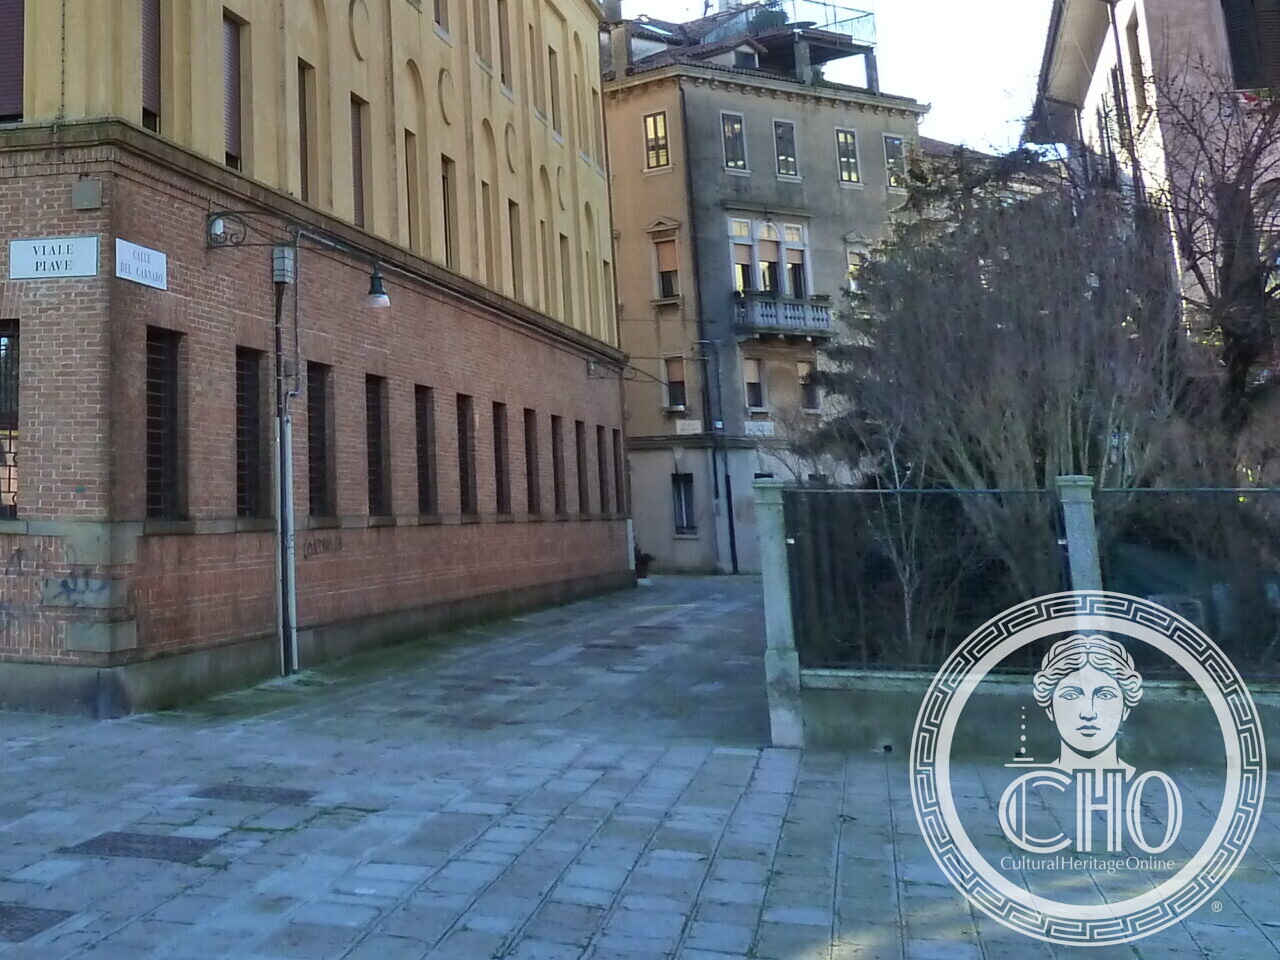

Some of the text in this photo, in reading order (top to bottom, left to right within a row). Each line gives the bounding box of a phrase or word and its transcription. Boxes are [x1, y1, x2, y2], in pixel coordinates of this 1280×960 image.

[32, 243, 74, 256] VIALE
[132, 248, 152, 264] CALLE
[35, 259, 73, 272] PIAVE
[120, 261, 132, 275] DEL
